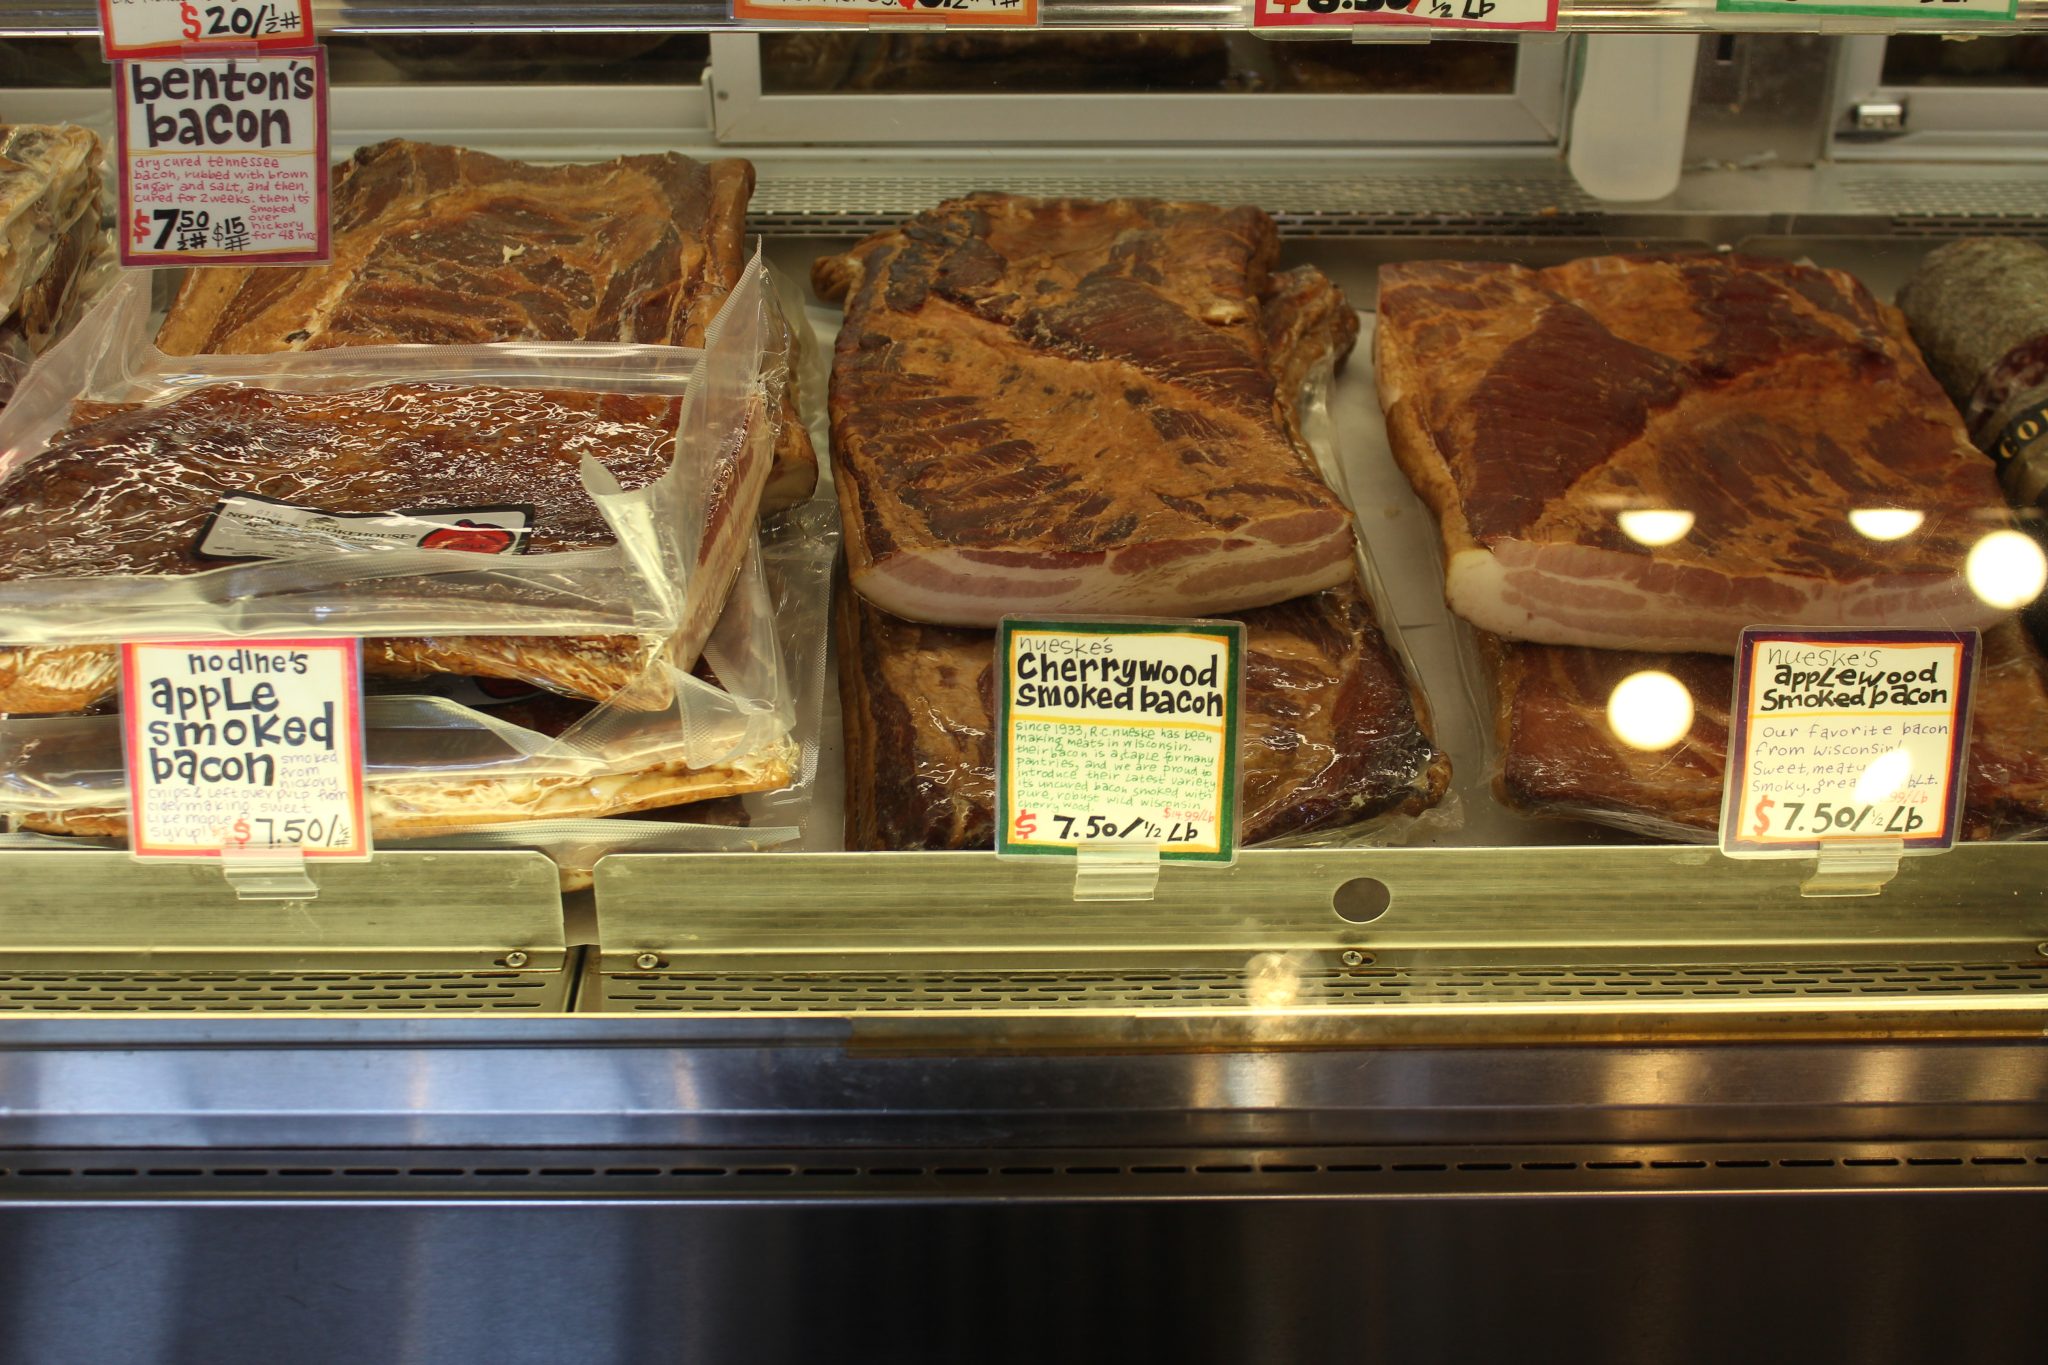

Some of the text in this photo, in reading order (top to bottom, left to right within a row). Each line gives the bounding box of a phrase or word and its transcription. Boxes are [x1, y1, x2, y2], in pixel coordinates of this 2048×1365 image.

[131, 61, 315, 104] benton's
[146, 104, 291, 148] bacon
[135, 156, 280, 170] dry cured tennessee
[134, 170, 308, 181] bacon, rubbed with brown
[135, 183, 174, 195] sugar
[179, 180, 205, 192] and
[247, 180, 270, 192] and
[134, 192, 173, 204] cured
[177, 193, 197, 203] for
[258, 193, 289, 203] then
[248, 213, 280, 222] over
[250, 205, 296, 214] smoked
[251, 221, 303, 232] hickory
[251, 230, 276, 240] for
[278, 231, 294, 240] 48
[1019, 637, 1114, 658] nueske's
[188, 649, 308, 675] nodine's
[1768, 648, 1881, 668] nueske's
[1017, 653, 1218, 688] Cherrywood
[1141, 685, 1224, 717] bacon
[1868, 684, 1948, 709] bacon
[149, 701, 334, 750] smoked
[1015, 721, 1051, 732] since
[1055, 724, 1087, 739] 1933,
[1161, 728, 1180, 739] has
[1184, 729, 1212, 743] been
[1808, 723, 1893, 739] favorite
[1902, 722, 1948, 736] bacon
[1016, 733, 1063, 752] making
[1067, 738, 1104, 748] meats
[1108, 738, 1119, 747] in
[1755, 741, 1805, 757] from
[280, 752, 338, 764] smoked
[1016, 744, 1048, 755] their
[1051, 748, 1087, 758] bacon
[1095, 748, 1105, 758] is
[1163, 751, 1181, 764] for
[1183, 754, 1214, 767] many
[149, 748, 275, 787] bacon
[280, 767, 320, 778] from
[1016, 757, 1212, 777] pantries, and we are proud to
[1017, 768, 1077, 779] introduce
[1086, 770, 1120, 780] their
[1171, 777, 1216, 792] variety
[1813, 778, 1857, 794] grea
[317, 789, 349, 801] from
[1017, 789, 1054, 801] pure,
[1057, 791, 1100, 802] robust
[1038, 780, 1088, 792] uncured
[1093, 782, 1127, 794] bacon
[1133, 786, 1179, 798] smoked
[1184, 790, 1212, 800] with
[260, 803, 312, 813] sweet
[1018, 800, 1060, 813] cherry
